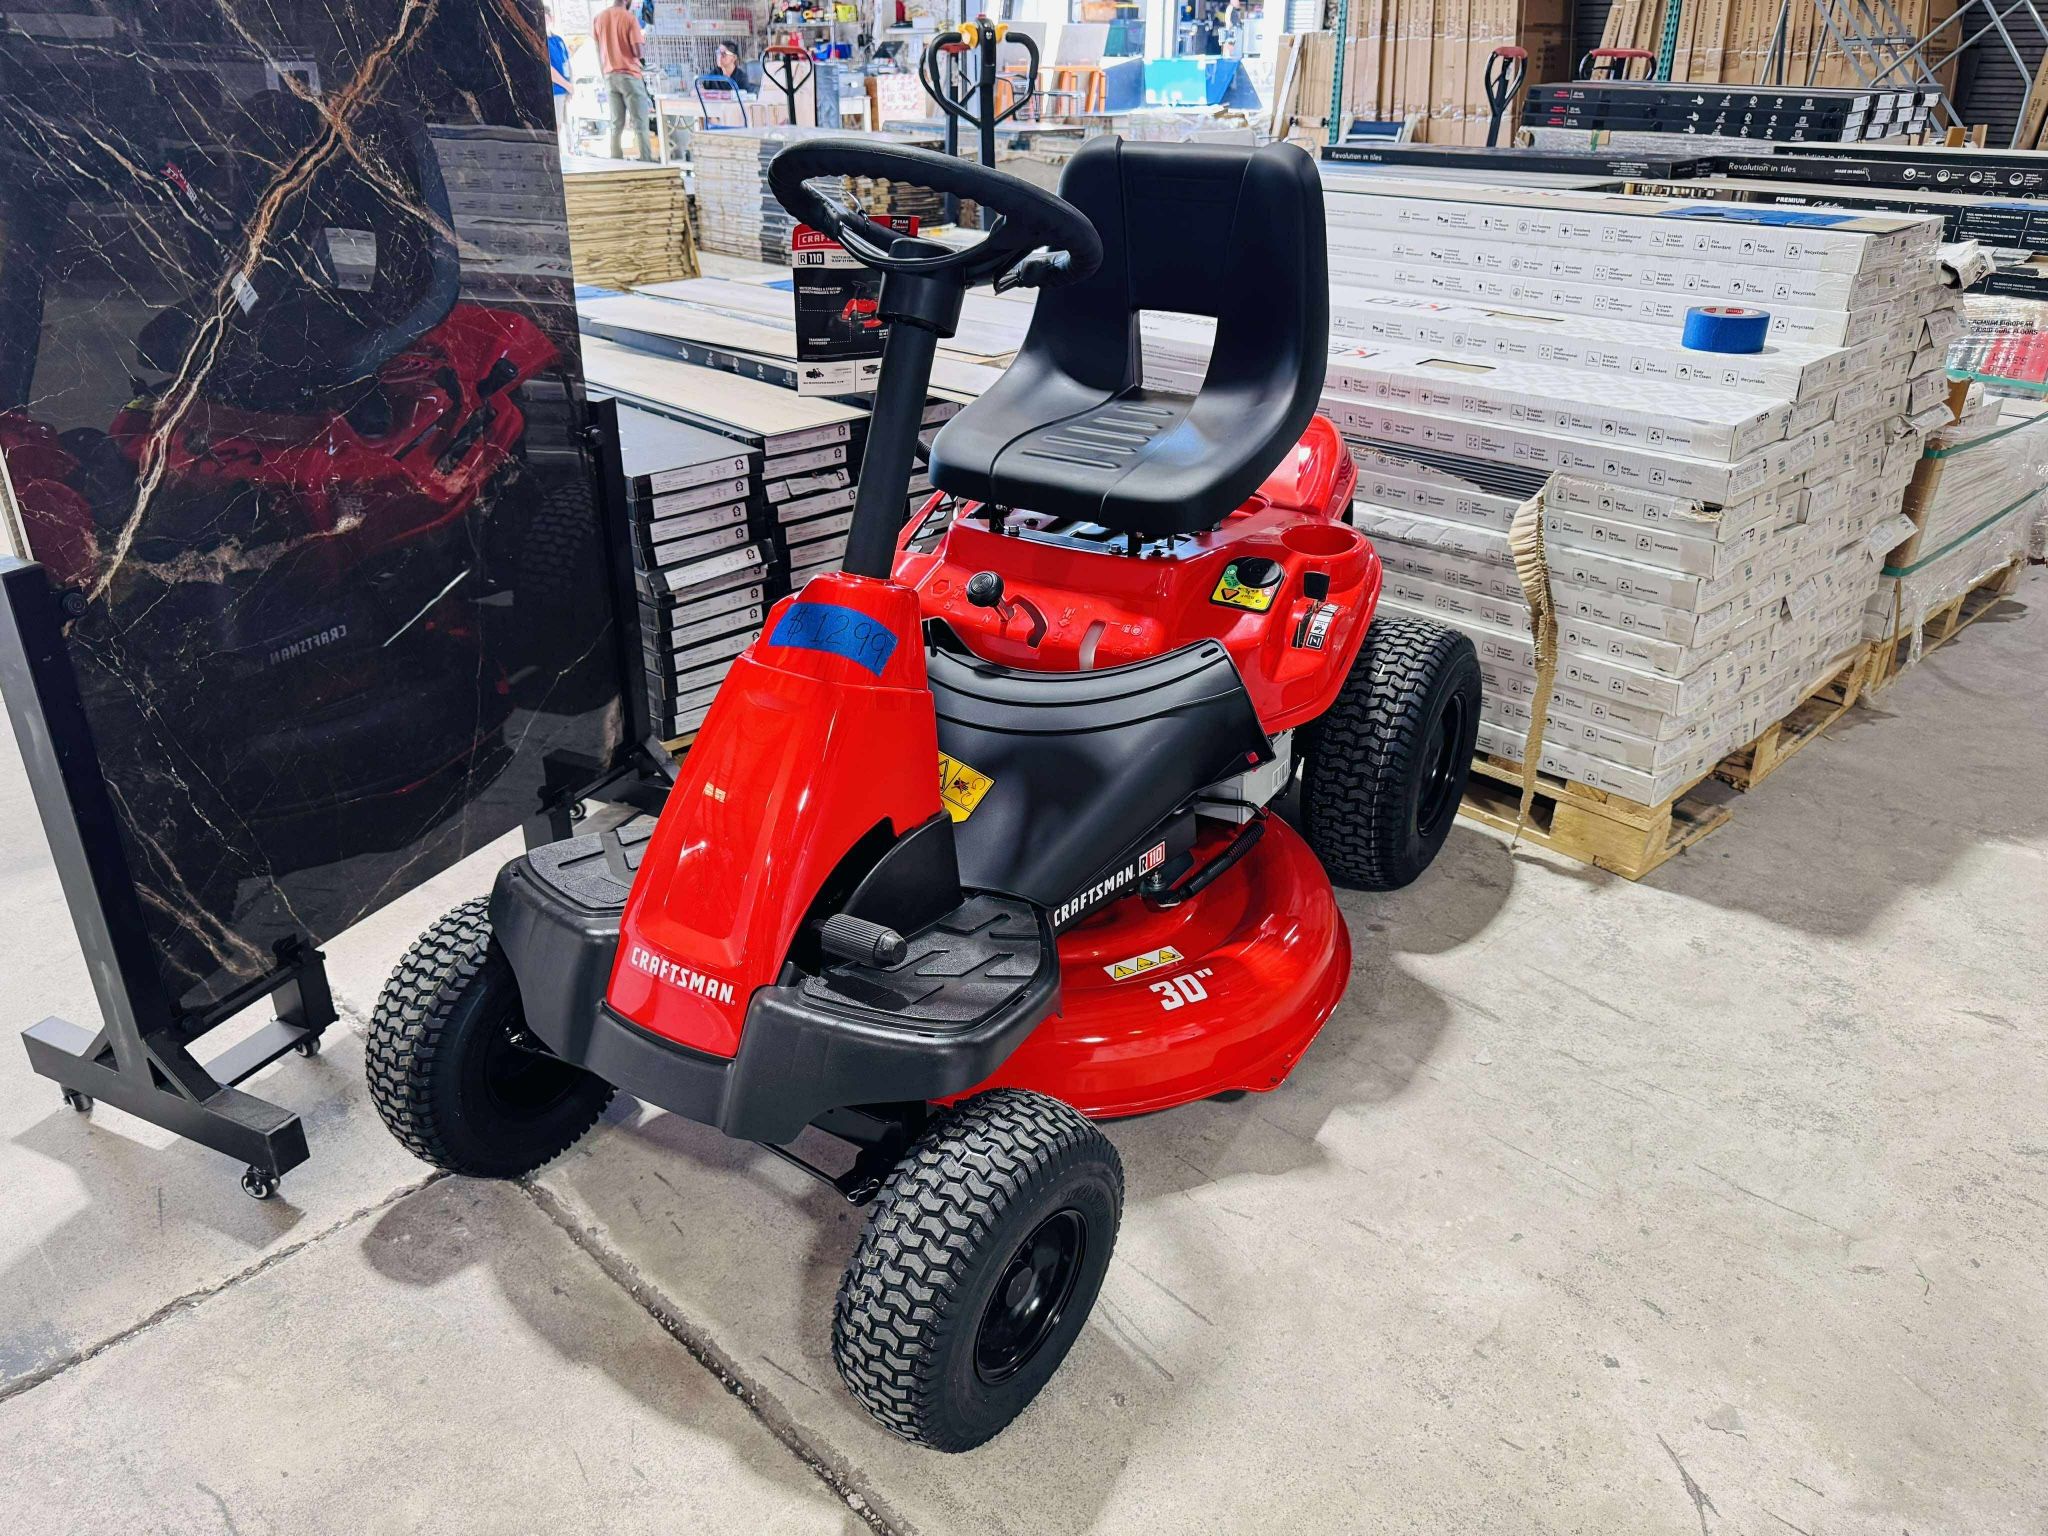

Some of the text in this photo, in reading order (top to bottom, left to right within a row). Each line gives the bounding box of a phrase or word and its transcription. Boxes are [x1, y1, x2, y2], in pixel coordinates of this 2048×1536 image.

[1332, 152, 1361, 160] Revolution
[1728, 162, 1768, 172] Revolution
[786, 607, 888, 666] $1299
[1053, 864, 1134, 927] CRAFTSMAN
[631, 947, 735, 1004] CRAFTSMAN
[1149, 968, 1213, 1011] 30"
